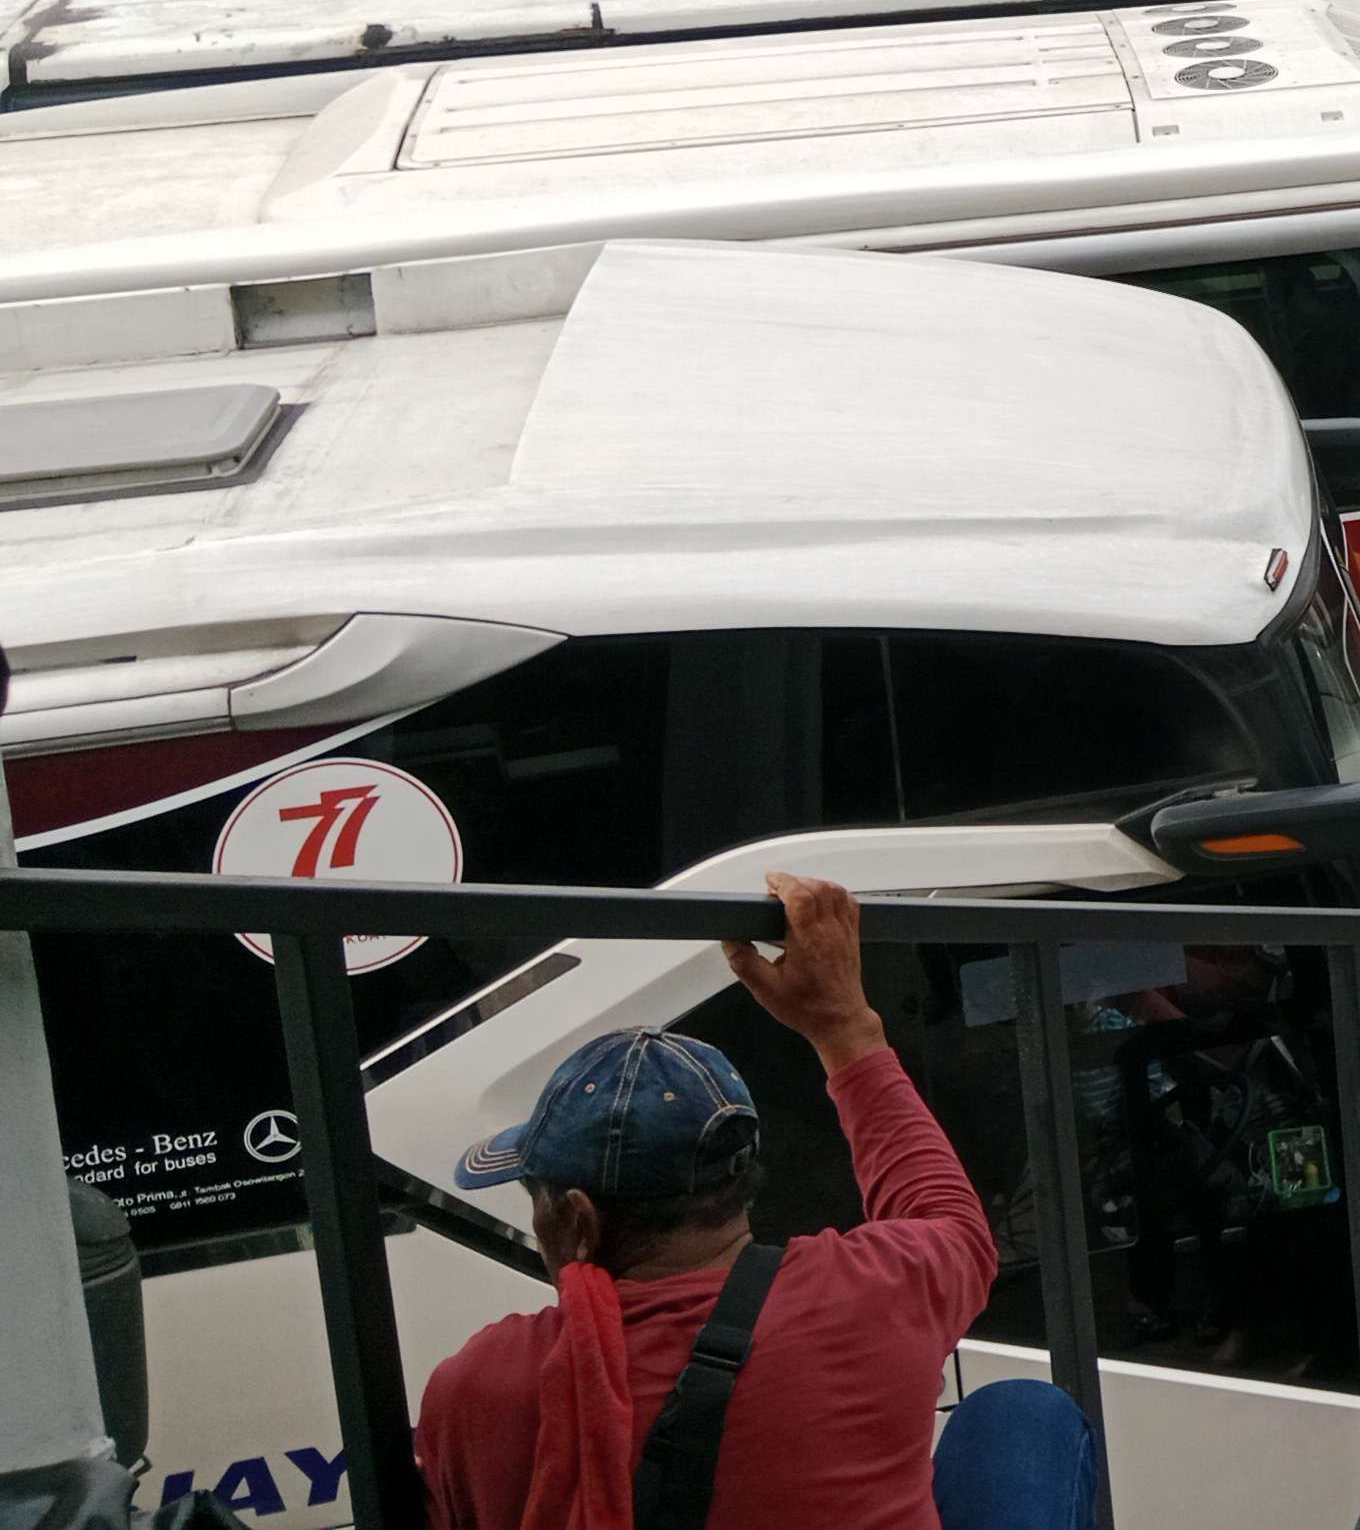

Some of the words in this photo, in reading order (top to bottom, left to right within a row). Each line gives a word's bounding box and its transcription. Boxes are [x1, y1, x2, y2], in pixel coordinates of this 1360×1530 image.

[279, 784, 382, 879] 77
[63, 1144, 128, 1171] cedes
[152, 1130, 218, 1156] Benz
[134, 1160, 159, 1176] for
[164, 1152, 217, 1171] buses
[160, 1446, 354, 1518] AY
